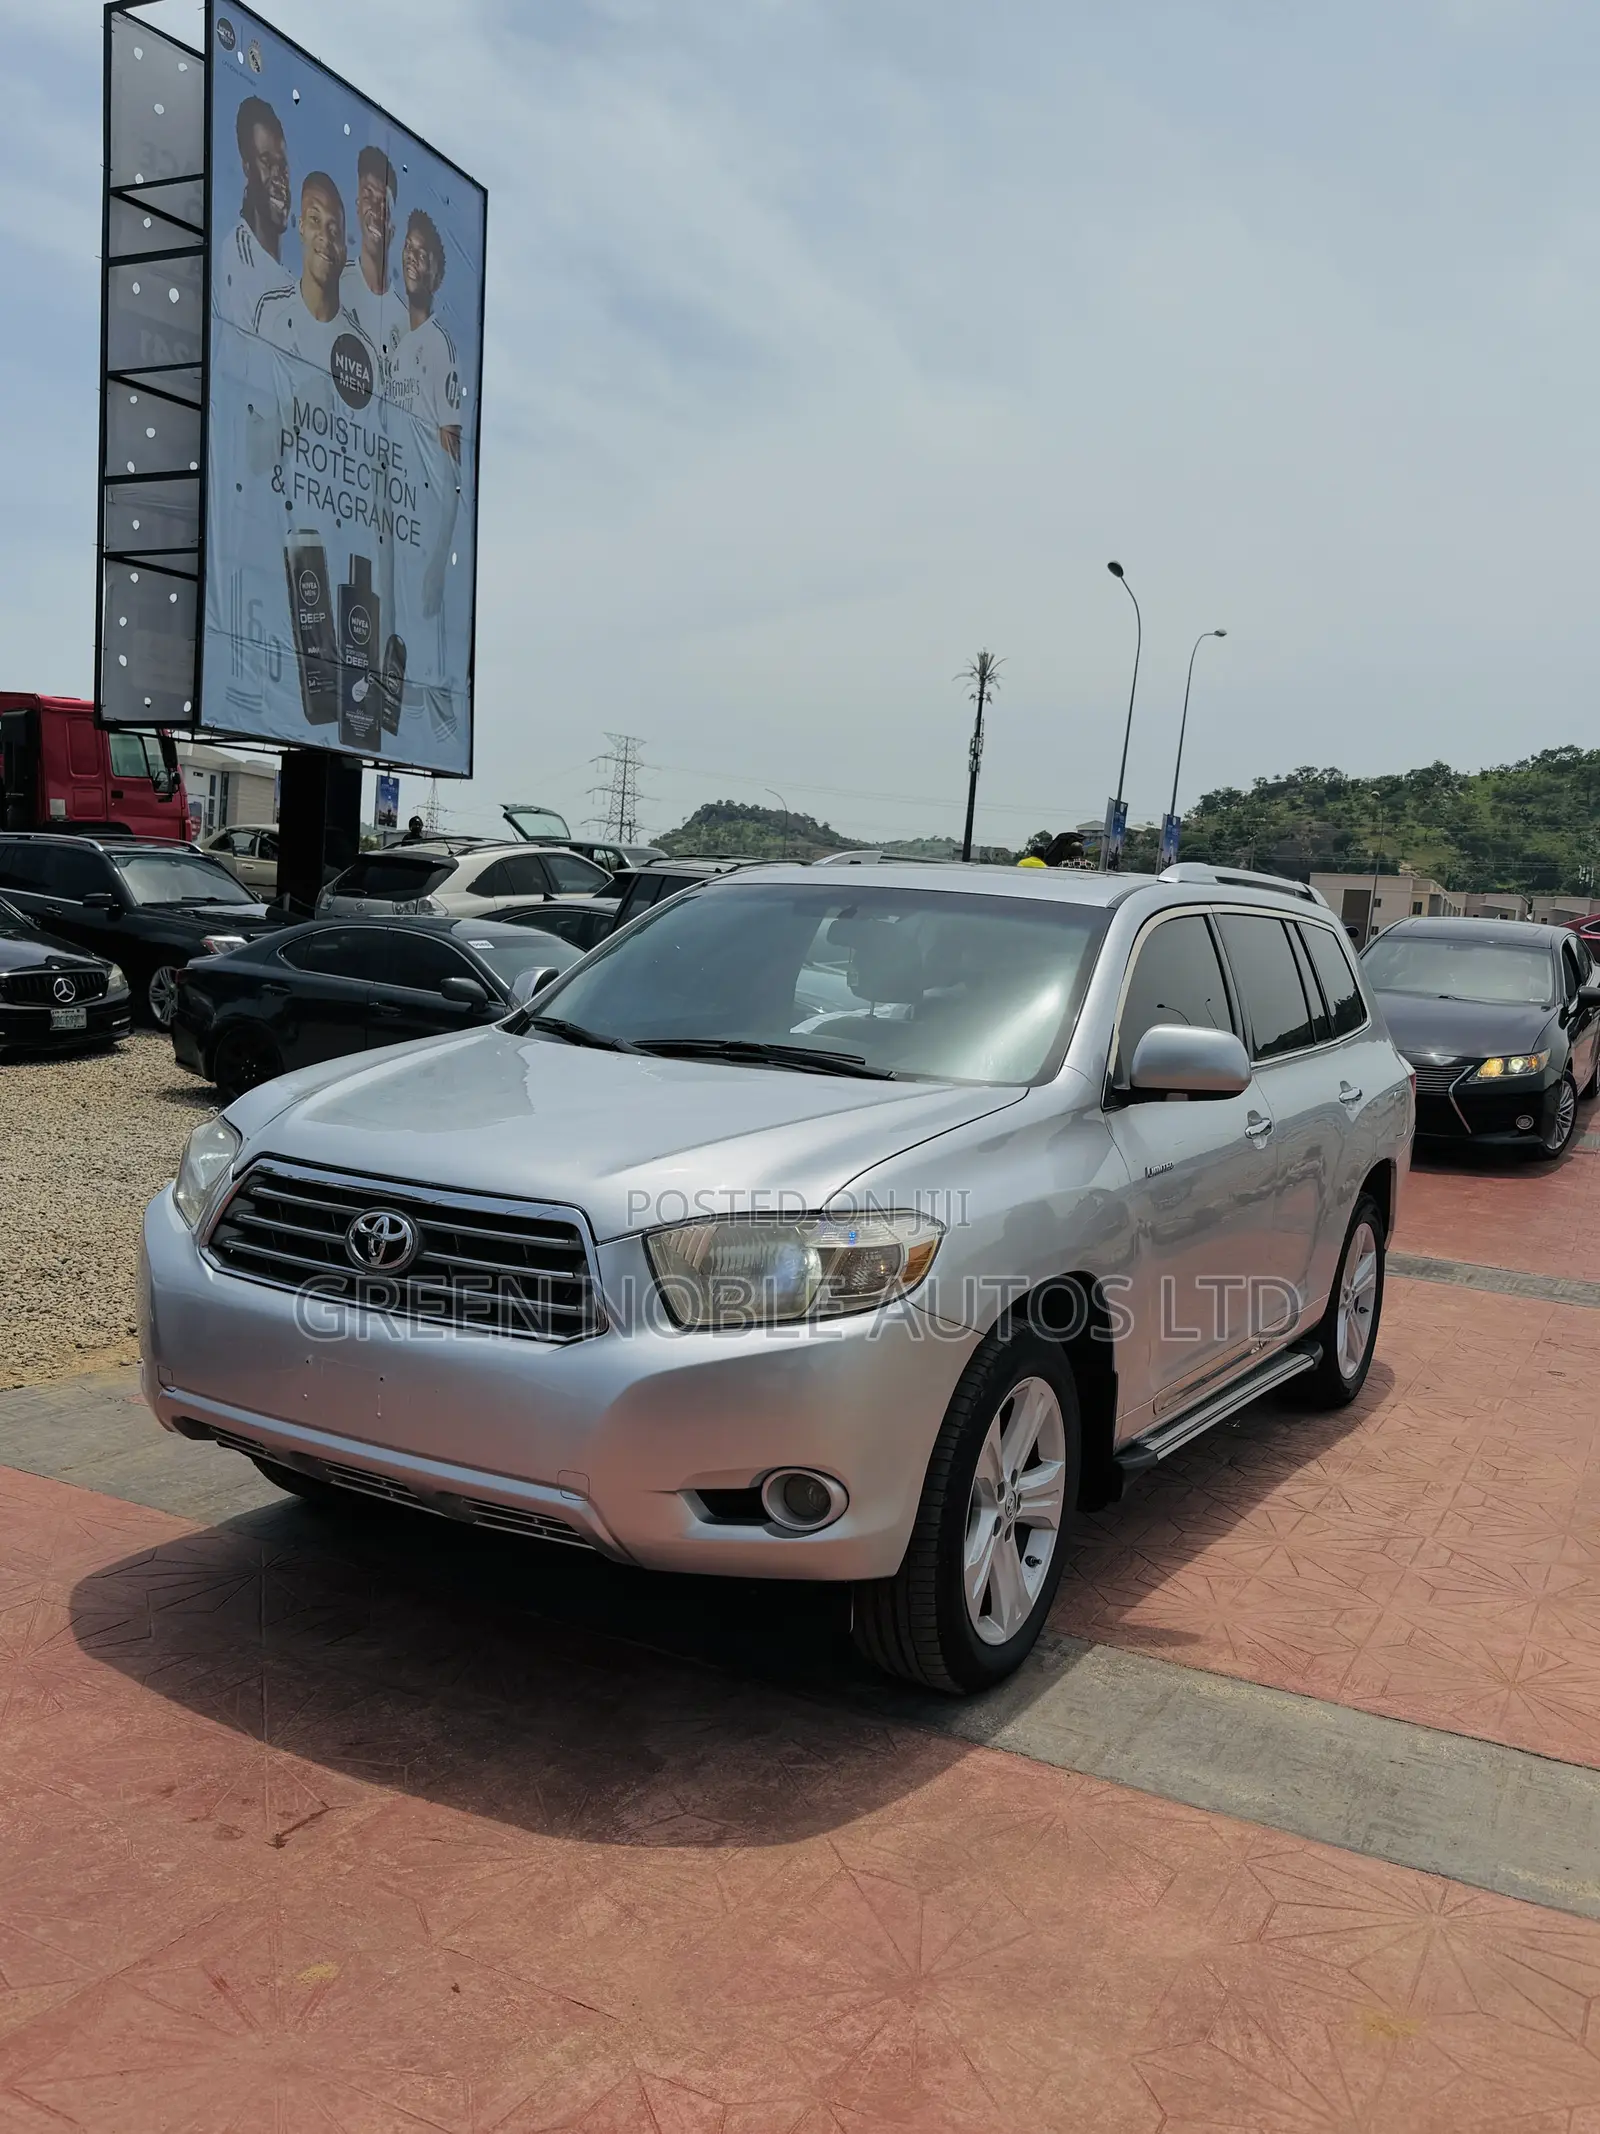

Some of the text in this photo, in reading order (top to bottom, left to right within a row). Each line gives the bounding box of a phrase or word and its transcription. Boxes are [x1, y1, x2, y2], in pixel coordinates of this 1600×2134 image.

[335, 352, 371, 383] NIVEA
[339, 372, 366, 395] MEN
[293, 396, 408, 478] MOISTURE,
[281, 428, 417, 511] PROTECTION
[271, 464, 421, 548] & FRAGRANCE
[300, 612, 326, 624] DEEP
[351, 616, 369, 629] NIVEA
[346, 655, 369, 668] DEEP
